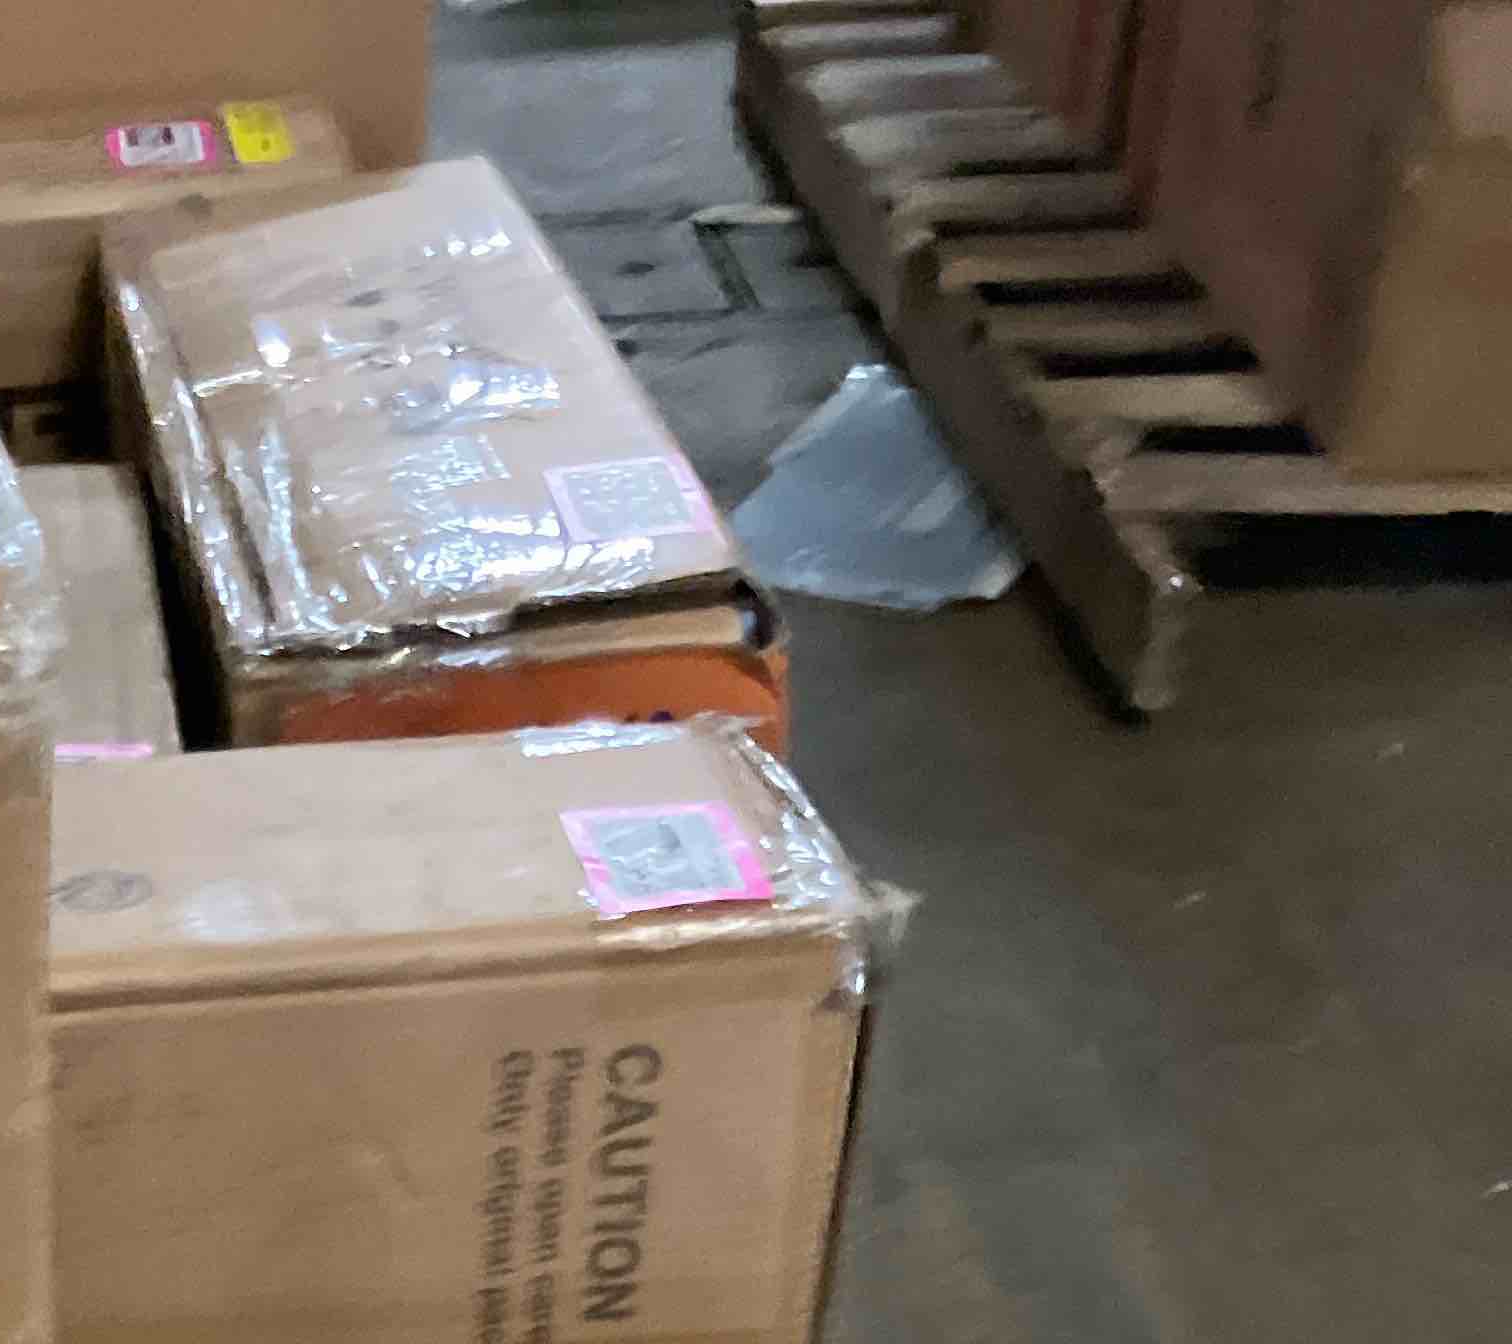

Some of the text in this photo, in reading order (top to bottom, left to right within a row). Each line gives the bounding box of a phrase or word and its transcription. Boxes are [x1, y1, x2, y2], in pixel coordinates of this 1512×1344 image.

[479, 1050, 534, 1136] Only
[541, 1047, 585, 1168] Please
[472, 1146, 523, 1277] original
[530, 1178, 564, 1262] open
[583, 1043, 663, 1325] CAUTION
